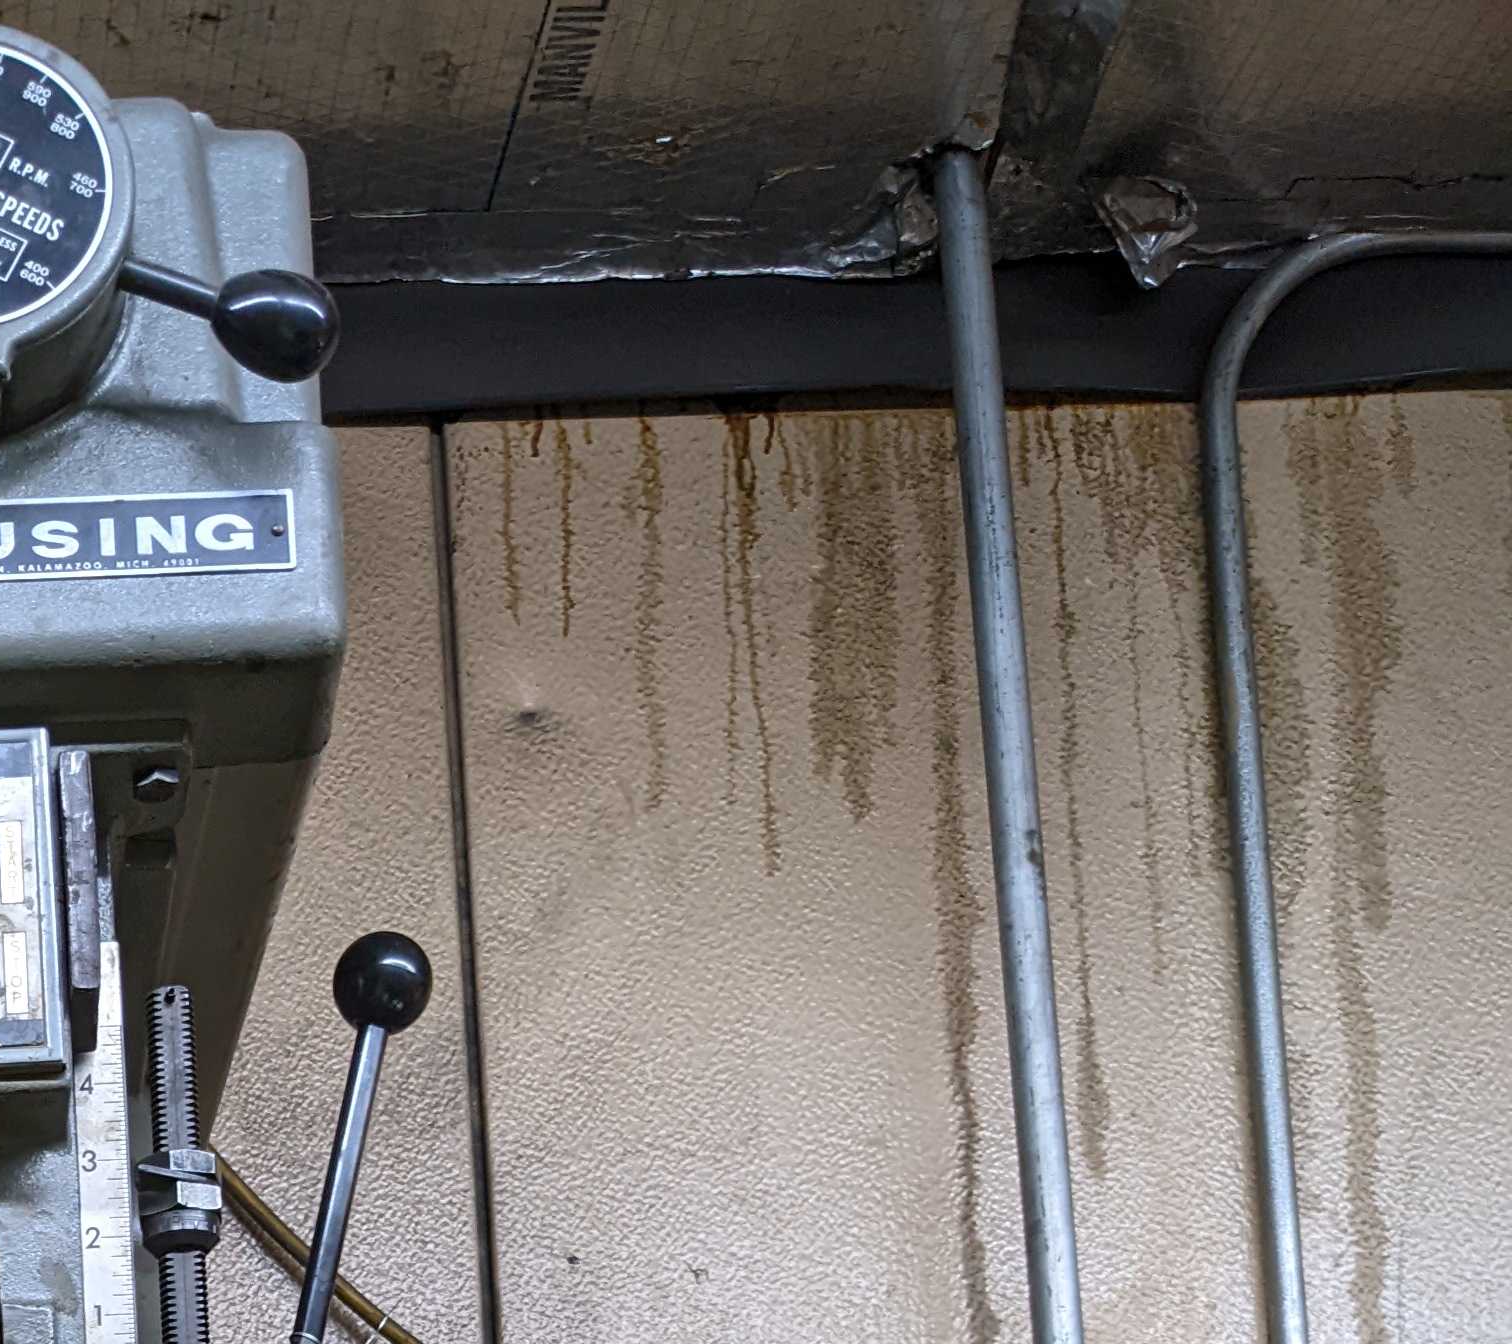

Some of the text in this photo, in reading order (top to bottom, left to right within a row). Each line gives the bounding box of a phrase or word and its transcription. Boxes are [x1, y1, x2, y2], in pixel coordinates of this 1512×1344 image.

[23, 89, 48, 106] 900
[50, 123, 75, 139] 800
[54, 114, 79, 131] 530
[9, 157, 49, 187] R.P.M.
[70, 181, 93, 197] 700
[72, 173, 97, 191] 460
[25, 261, 49, 276] 400
[20, 269, 44, 286] 600
[115, 559, 156, 570] MICH.
[8, 940, 23, 1004] STOP
[79, 1074, 94, 1096] 4
[81, 1150, 97, 1172] 3
[85, 1226, 101, 1249] 2
[94, 1304, 103, 1327] 1
